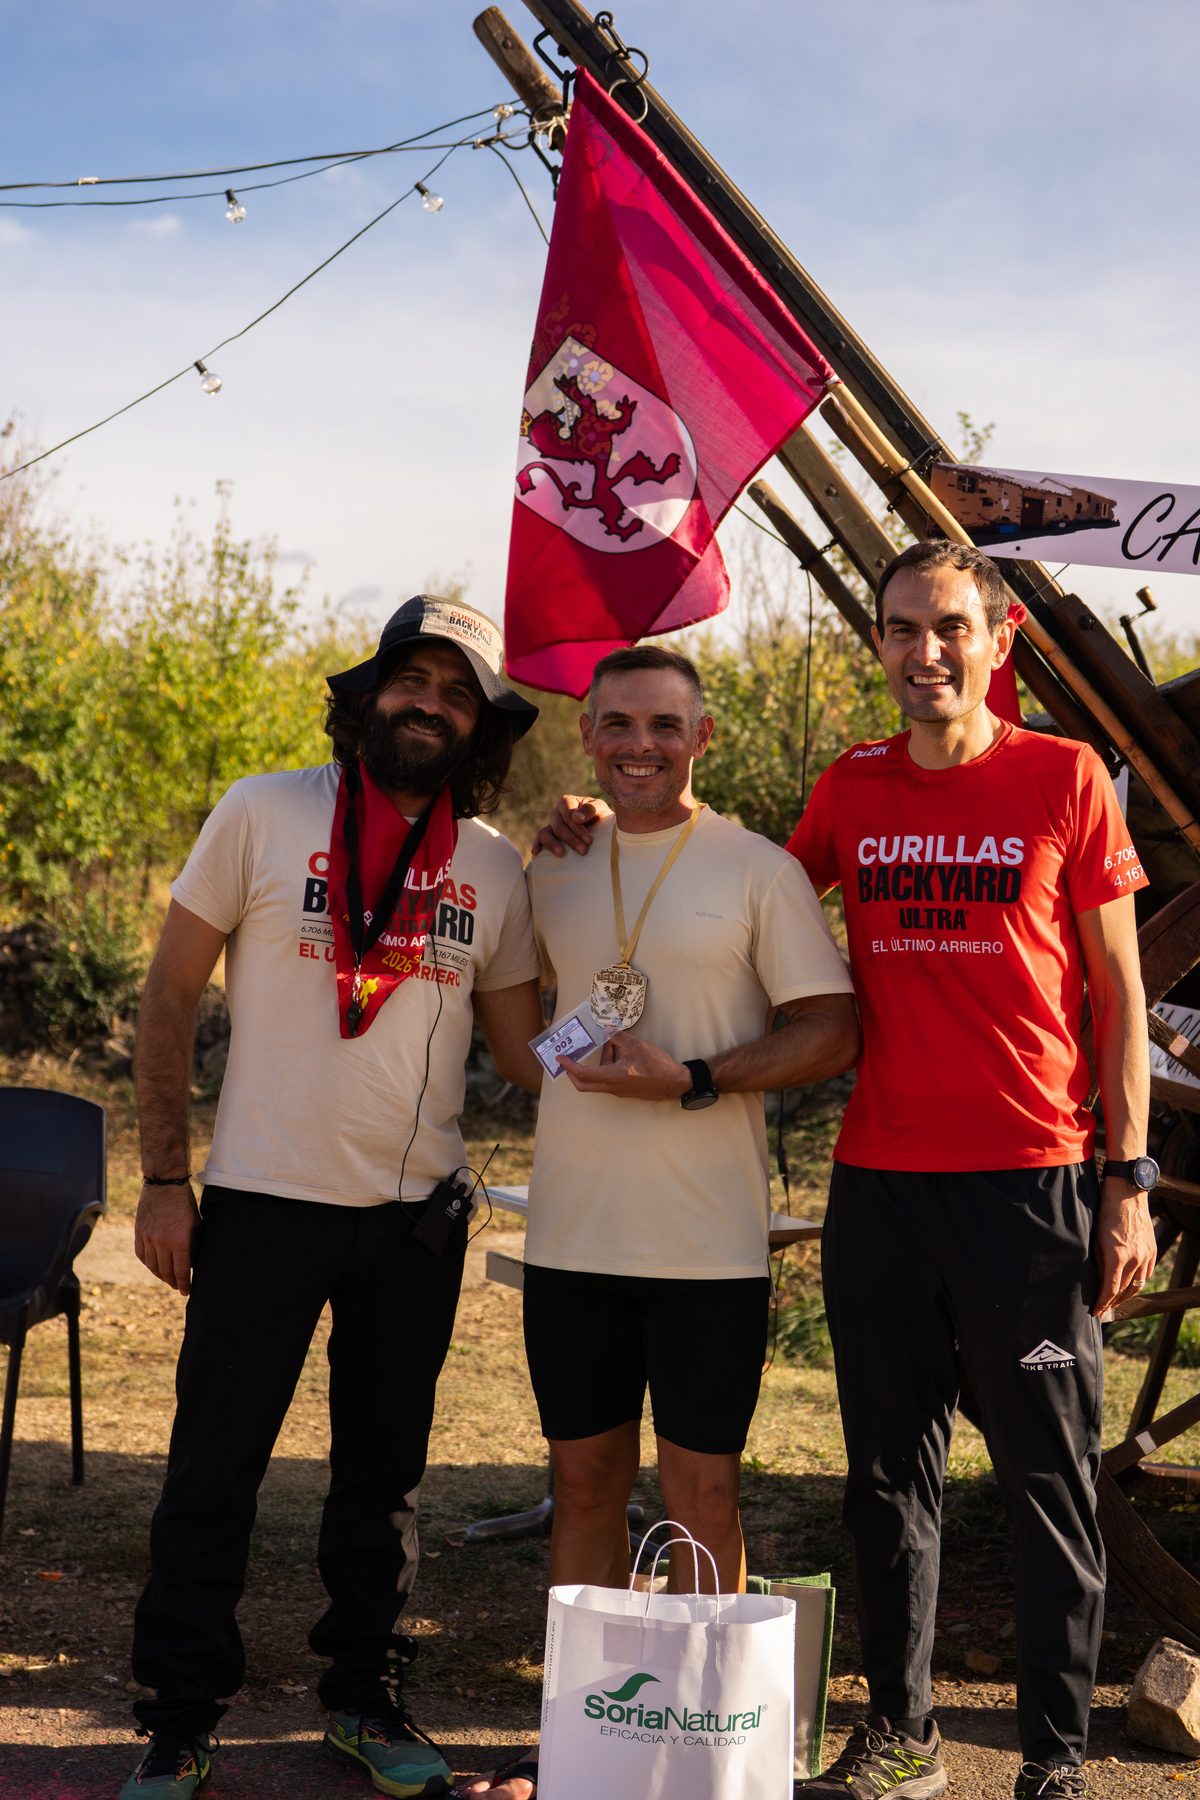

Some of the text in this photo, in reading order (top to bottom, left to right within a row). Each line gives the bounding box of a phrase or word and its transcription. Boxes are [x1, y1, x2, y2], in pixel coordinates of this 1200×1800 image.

[857, 834, 1025, 866] CURILLAS
[1104, 845, 1137, 870] 6.706
[857, 865, 1022, 904] BACKYARD
[1113, 864, 1145, 888] 4.167
[300, 925, 322, 936] 6.706
[299, 942, 320, 960] EL
[872, 937, 1004, 954] EL ÚLTIMO ARRIERO
[381, 950, 413, 973] 2026
[450, 952, 470, 967] MILES
[555, 1036, 573, 1053] 003
[1046, 1361, 1076, 1370] TRAIL
[600, 1725, 747, 1747] EFICACIA Y CALIDAD
